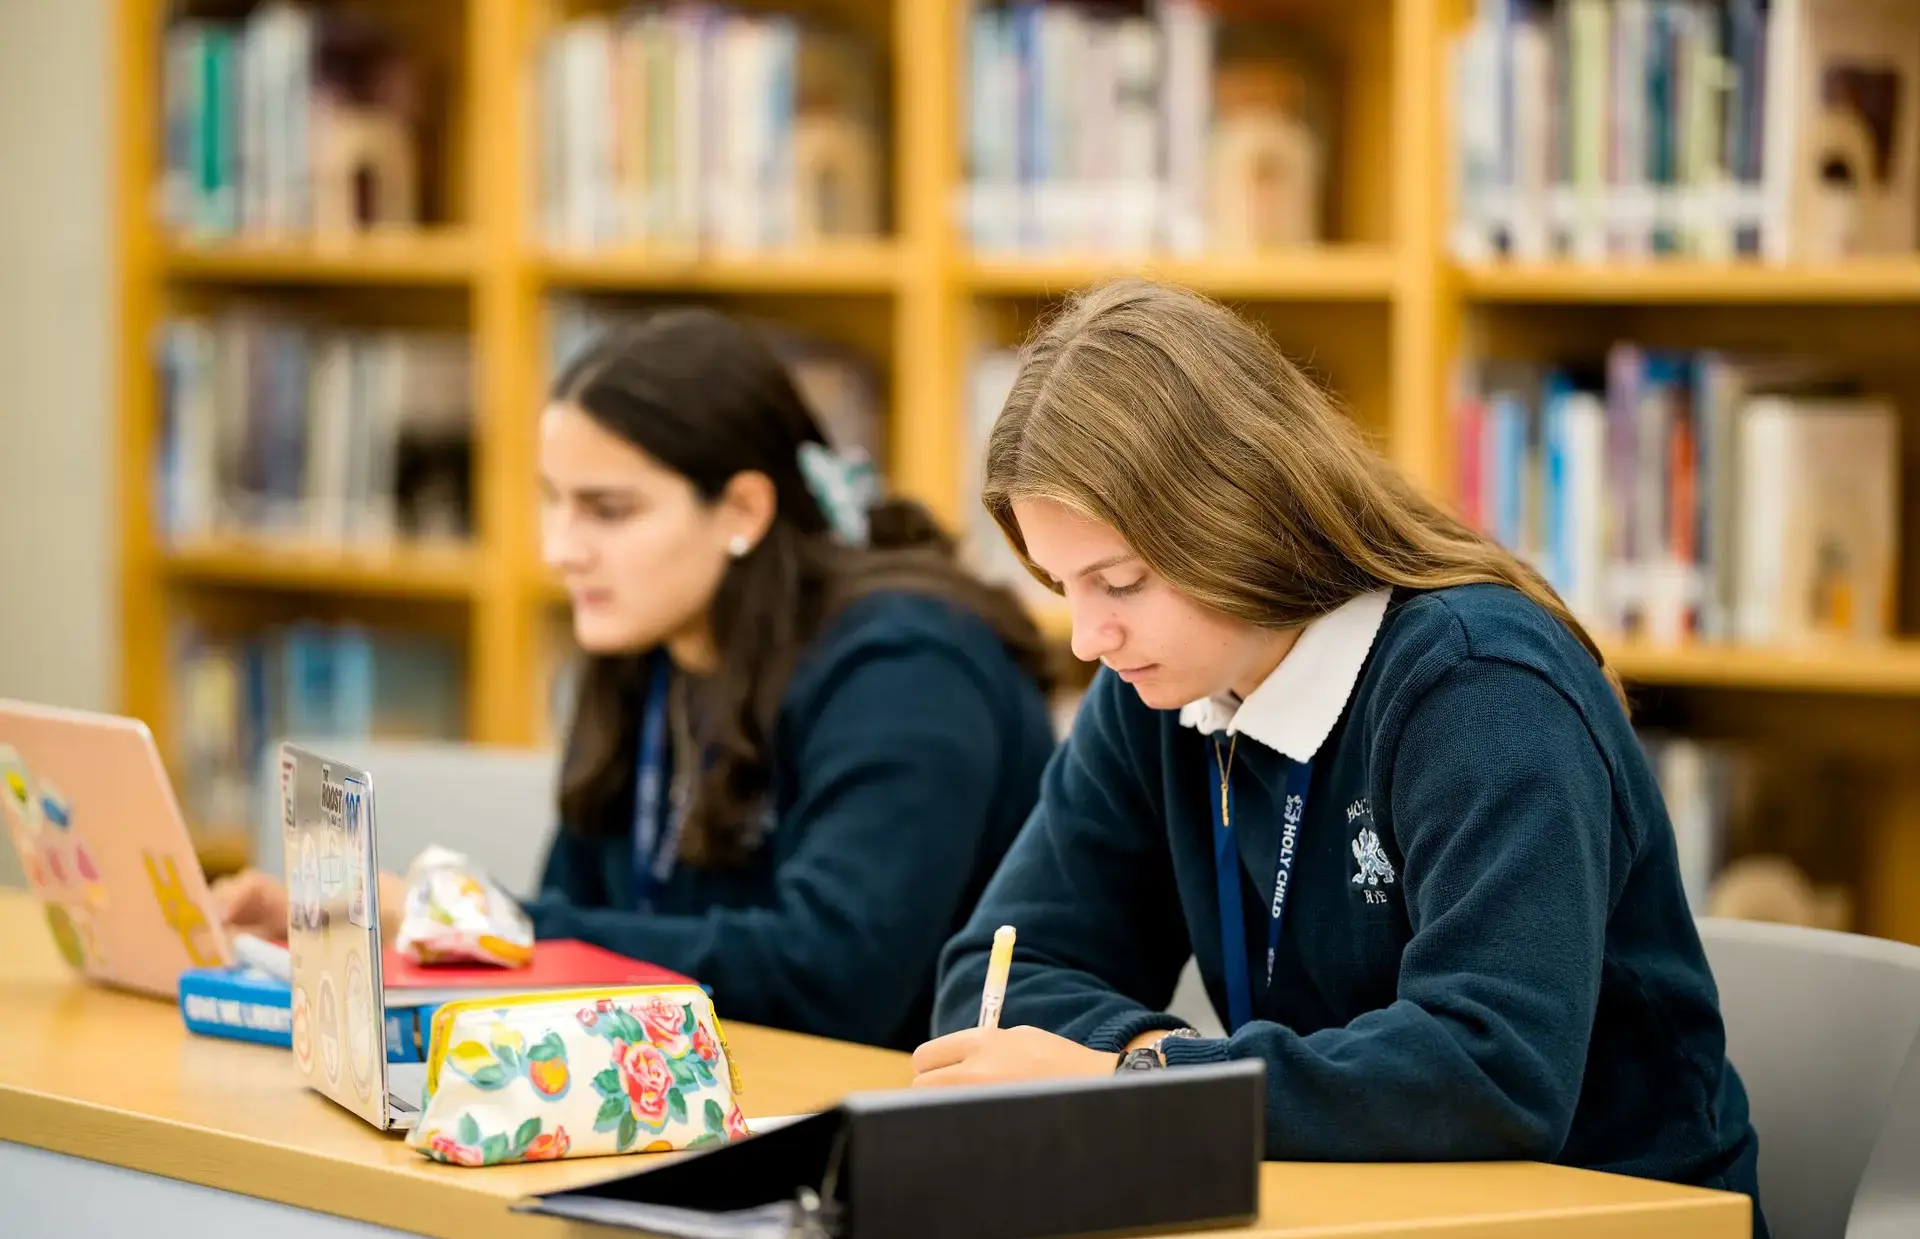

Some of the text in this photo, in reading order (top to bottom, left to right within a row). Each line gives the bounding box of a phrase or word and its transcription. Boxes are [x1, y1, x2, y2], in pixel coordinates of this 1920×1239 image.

[322, 783, 342, 814] ROOST
[1272, 823, 1297, 919] HOLY CHILD
